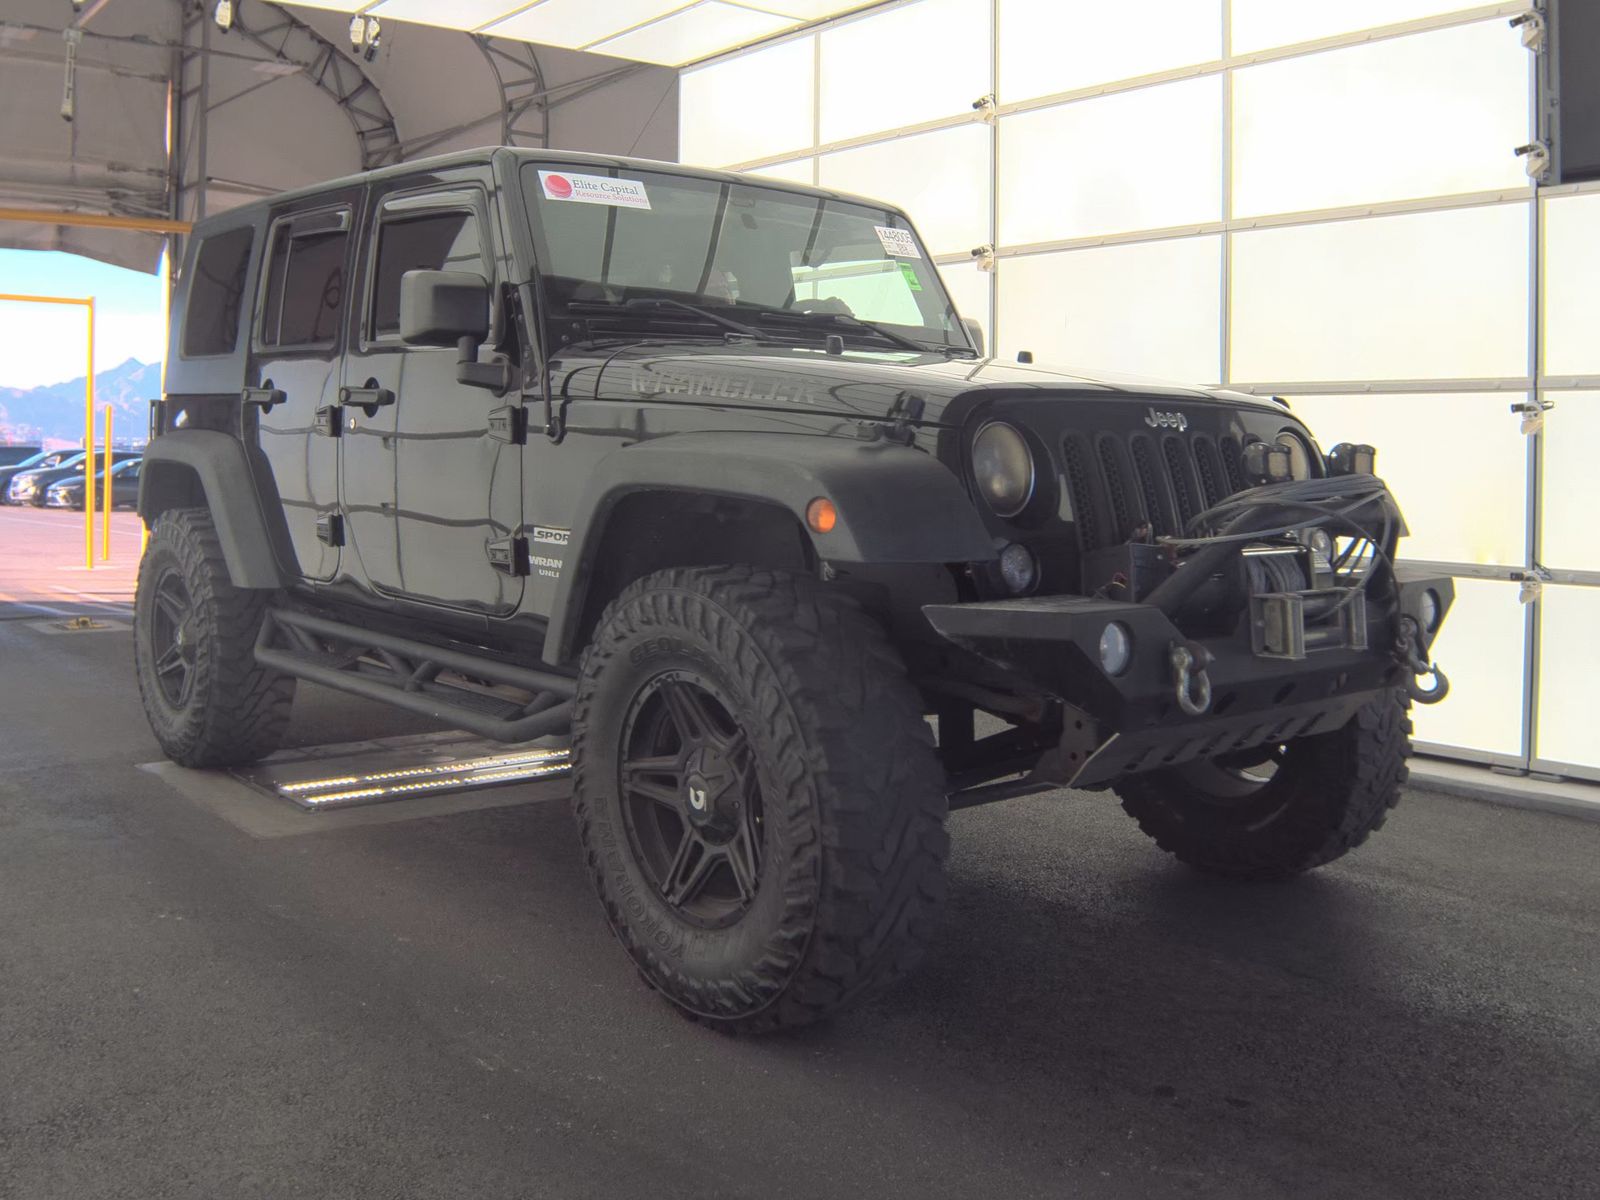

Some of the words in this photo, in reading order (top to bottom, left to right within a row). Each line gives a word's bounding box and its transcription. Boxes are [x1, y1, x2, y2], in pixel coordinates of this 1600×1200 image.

[573, 179, 598, 190] Elite
[600, 182, 639, 195] Capital
[575, 189, 611, 200] Resource
[613, 193, 647, 203] Solutions
[1144, 407, 1188, 432] Jeep
